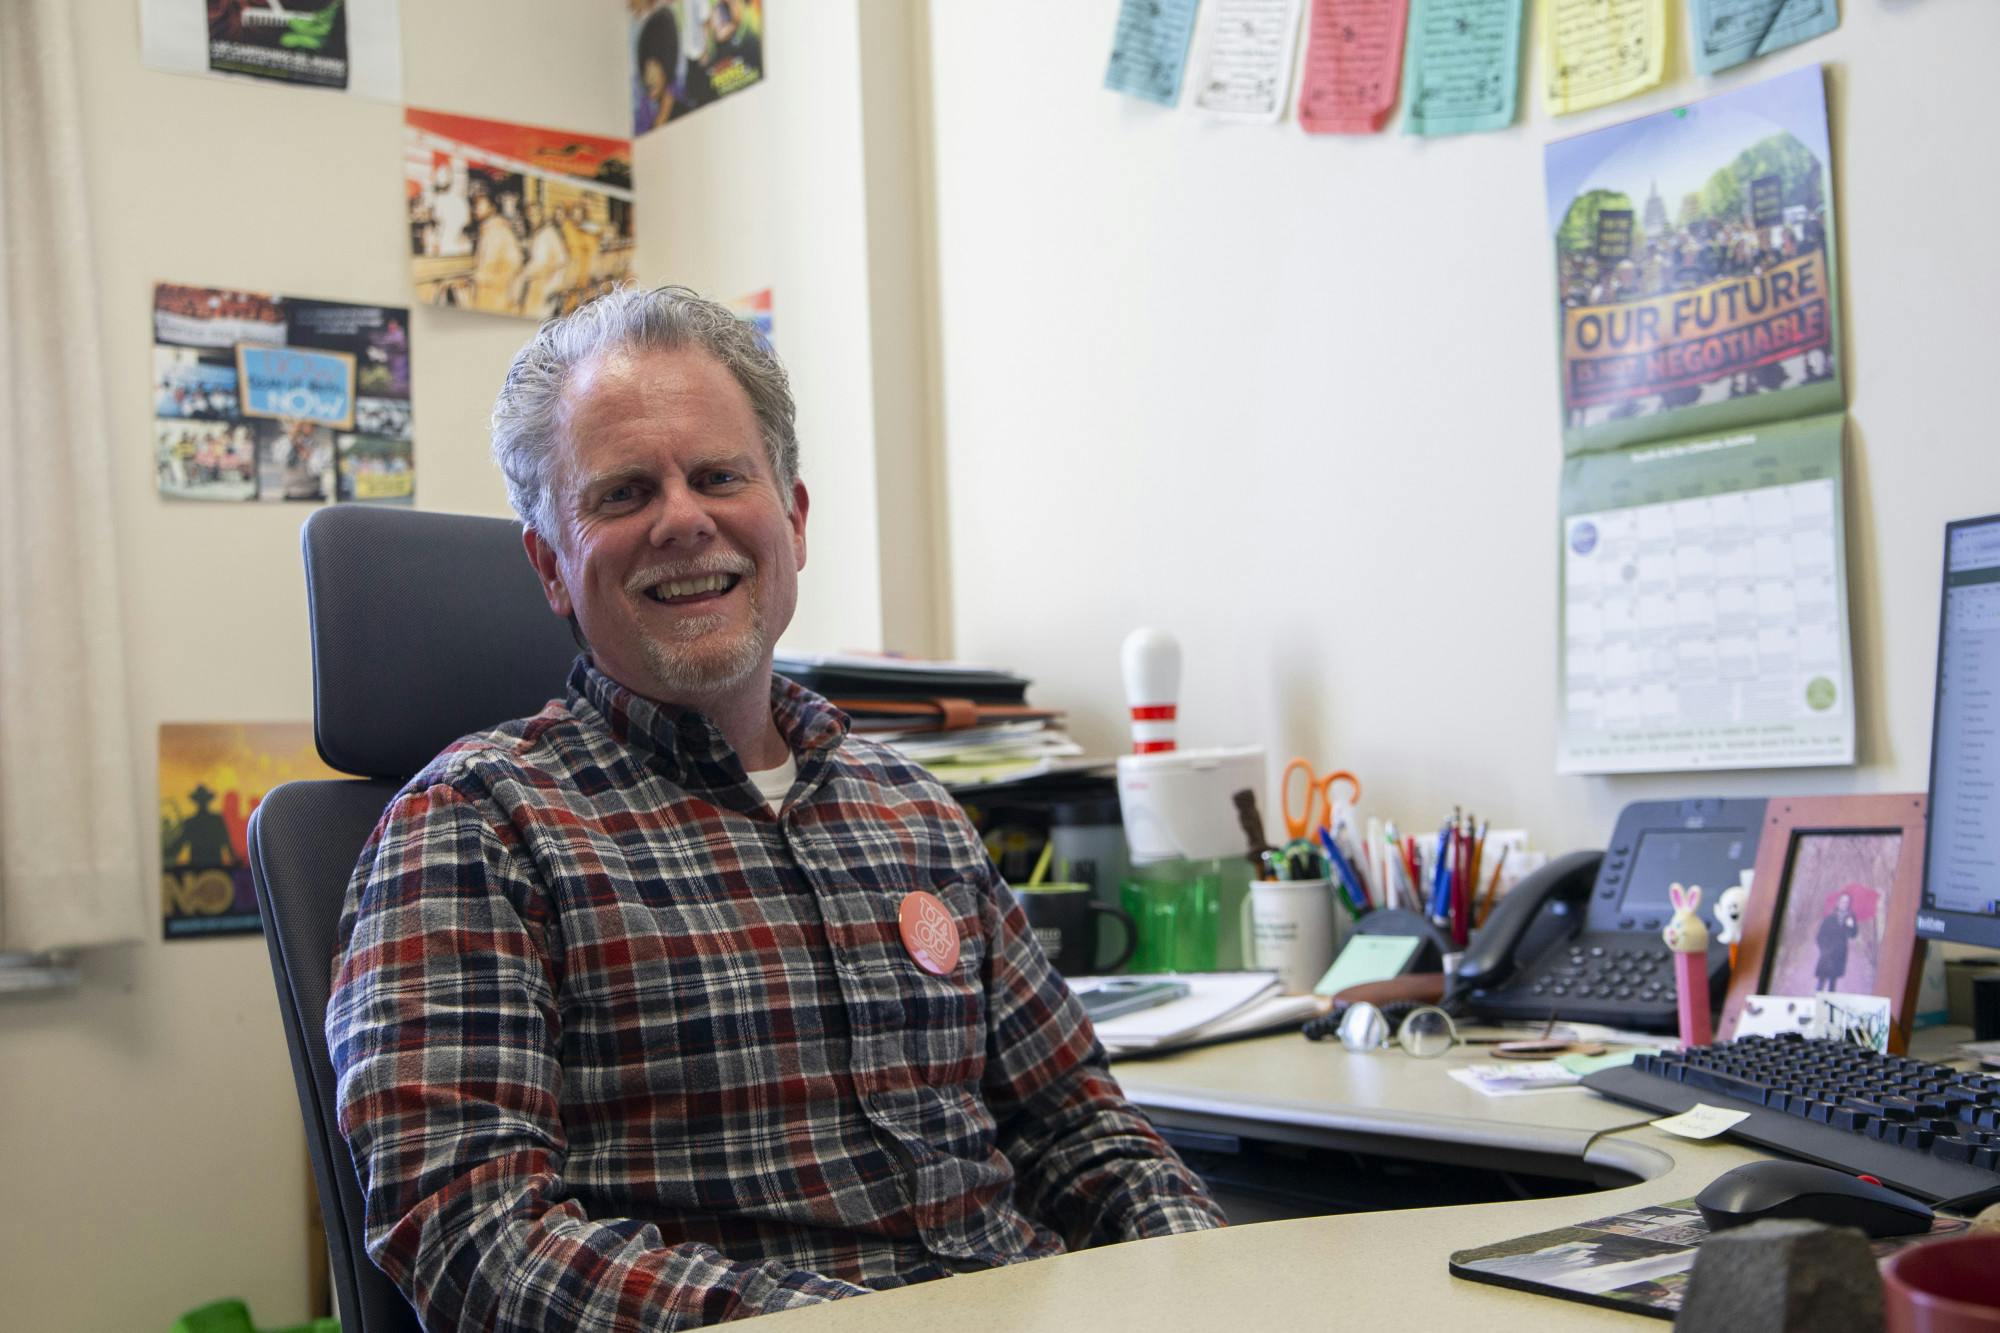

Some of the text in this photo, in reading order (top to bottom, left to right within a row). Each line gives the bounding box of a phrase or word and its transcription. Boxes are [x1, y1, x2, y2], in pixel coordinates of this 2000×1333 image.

[1577, 259, 1817, 351] OUR FUTURE
[1646, 303, 1825, 377] NEGOTIABLE
[267, 388, 345, 419] NOW
